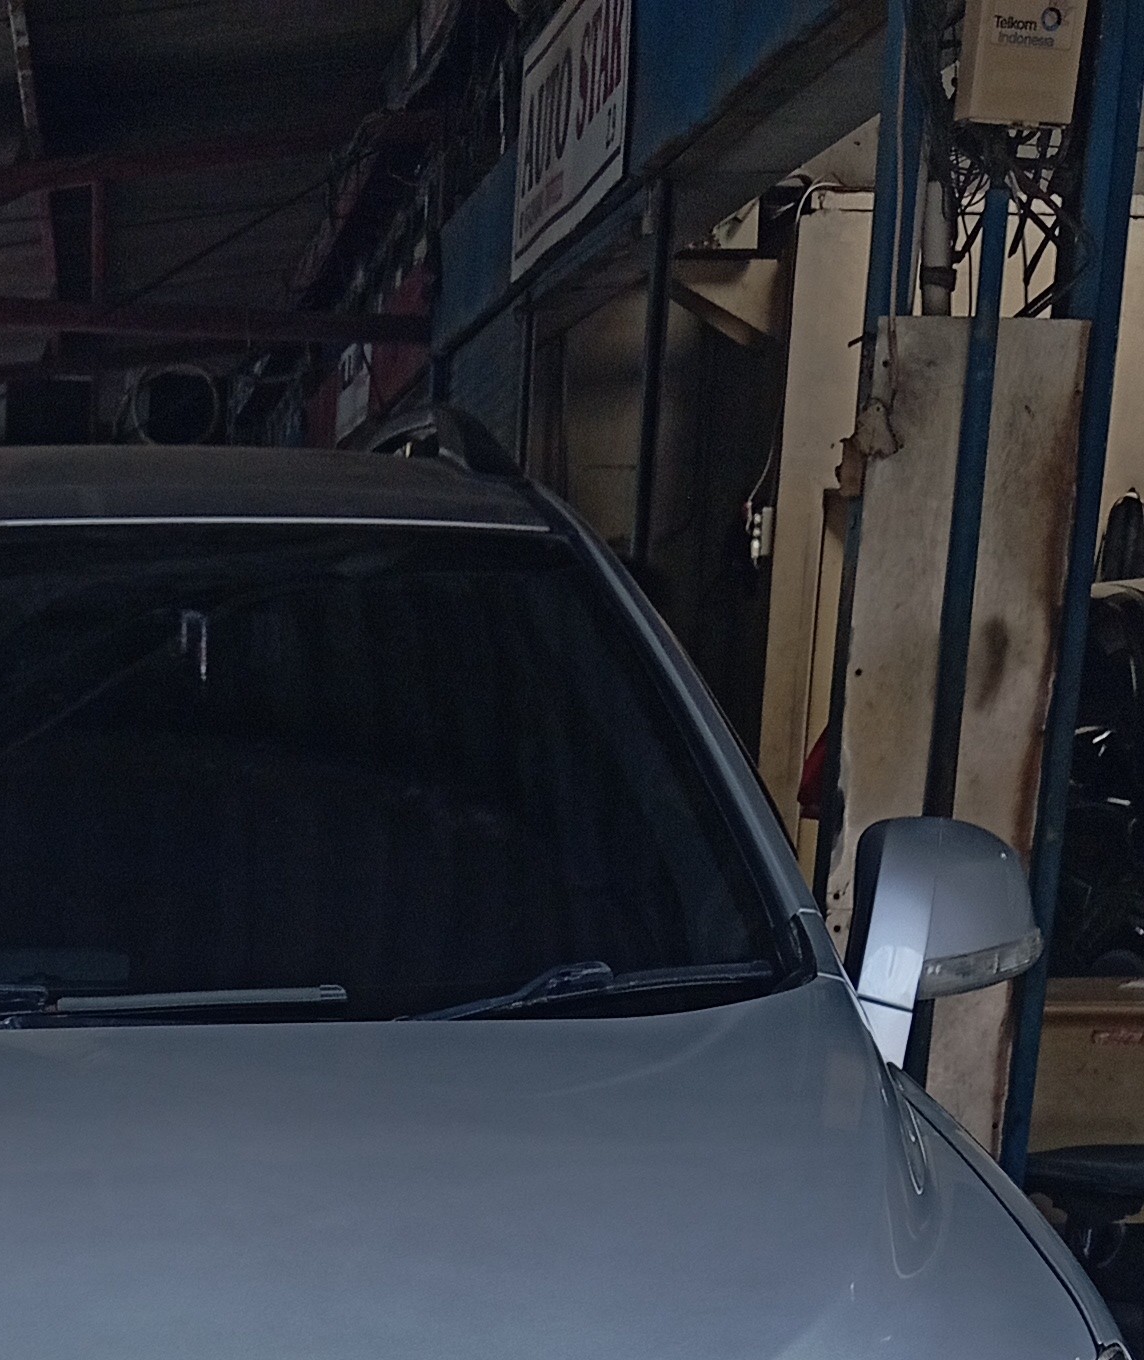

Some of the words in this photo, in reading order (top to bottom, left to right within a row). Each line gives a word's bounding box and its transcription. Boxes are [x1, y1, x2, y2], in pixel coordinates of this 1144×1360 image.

[994, 15, 1037, 31] Telkom
[998, 31, 1055, 47] Indonesia
[521, 47, 573, 199] AUTO
[576, 0, 625, 140] STAR
